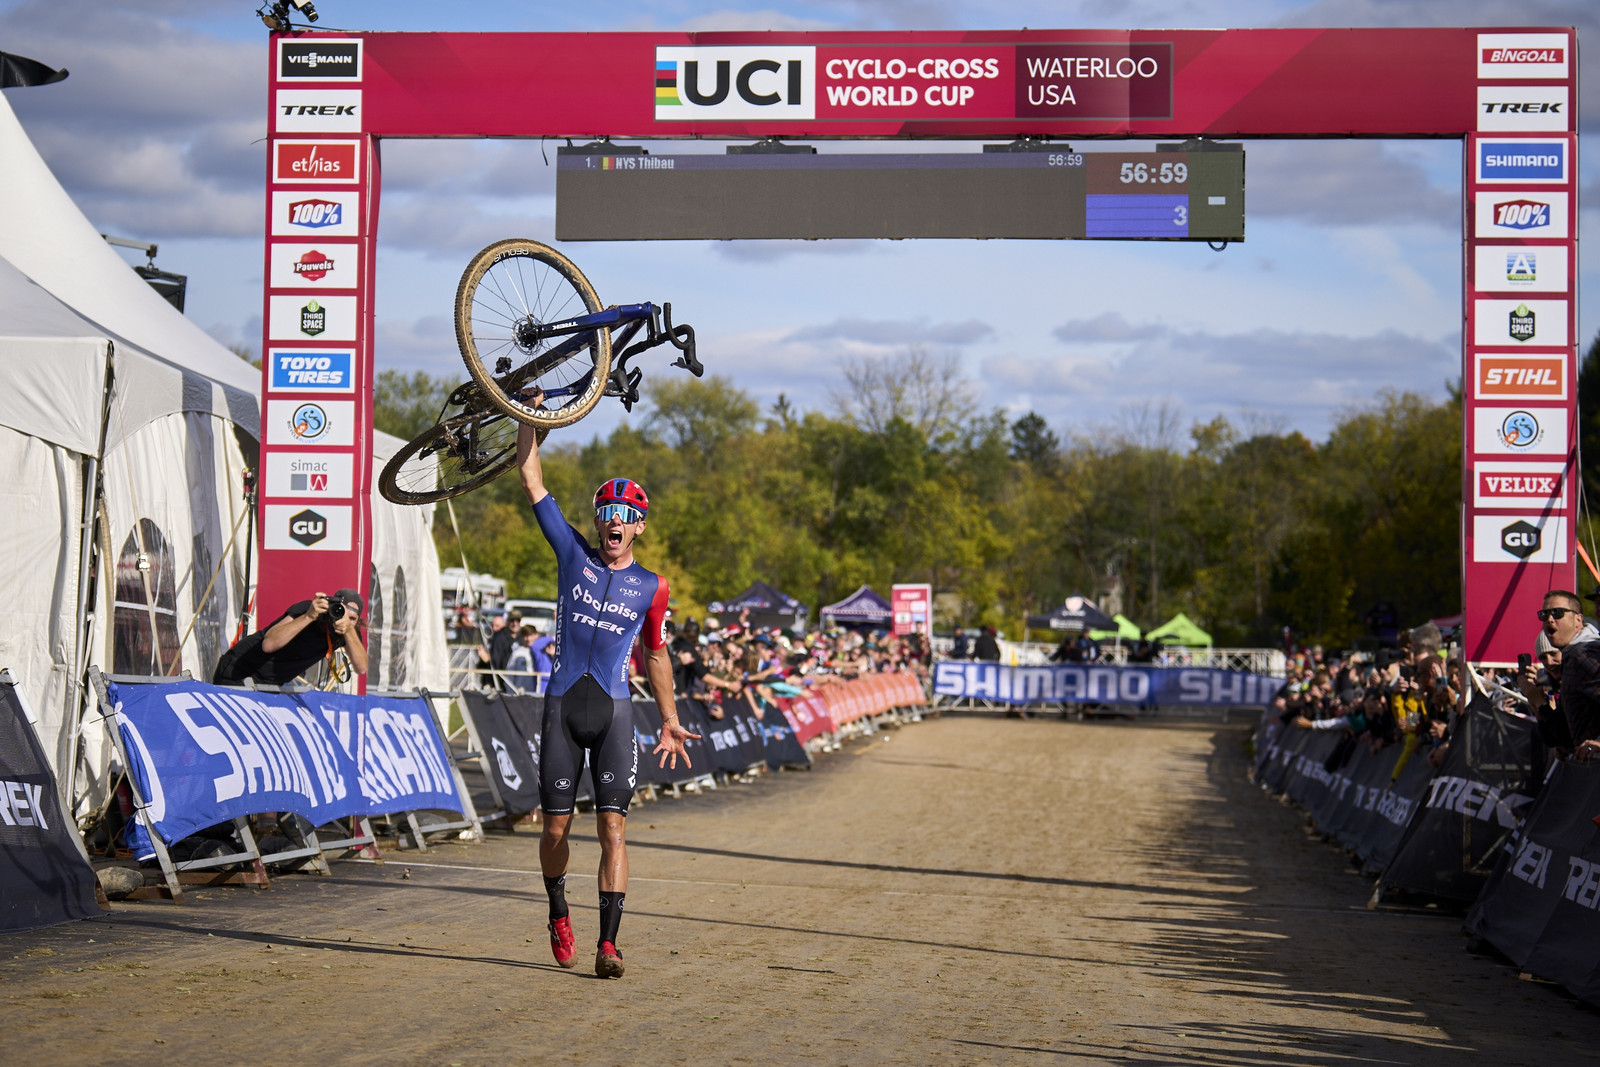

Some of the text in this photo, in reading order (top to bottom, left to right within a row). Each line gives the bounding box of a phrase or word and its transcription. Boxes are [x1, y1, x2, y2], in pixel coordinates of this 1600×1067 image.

[288, 53, 352, 67] VIESMANN
[825, 58, 999, 79] CYCLO-CROSS
[1026, 57, 1158, 78] WATERLOO
[684, 59, 802, 106] UCI
[826, 85, 975, 106] WORLD CUP
[1028, 85, 1077, 105] USA
[280, 105, 357, 116] TREK
[1481, 103, 1563, 113] TREK
[291, 145, 341, 177] ethias
[637, 157, 674, 169] Thibau
[1048, 154, 1083, 166] 56:59
[1485, 155, 1559, 167] SHIMANO
[1119, 162, 1188, 184] 56:59
[292, 203, 339, 224] 100%
[1173, 205, 1187, 226] 3
[1497, 204, 1547, 225] 100%
[296, 260, 332, 271] Pauwels
[303, 320, 323, 329] SPACE
[552, 321, 579, 331] TREK
[1511, 324, 1534, 334] SPACE
[280, 357, 331, 370] TOYO
[288, 371, 343, 384] TIRES
[1484, 368, 1558, 385] STIHL
[509, 376, 599, 418] BONTRAGER
[291, 459, 328, 472] simac
[1485, 477, 1552, 493] VELUX
[292, 521, 323, 535] GU
[1504, 532, 1537, 546] GU
[582, 589, 638, 621] baloise
[572, 612, 626, 635] TREK
[936, 664, 1151, 700] SHIMANO
[1427, 775, 1535, 830] TREK
